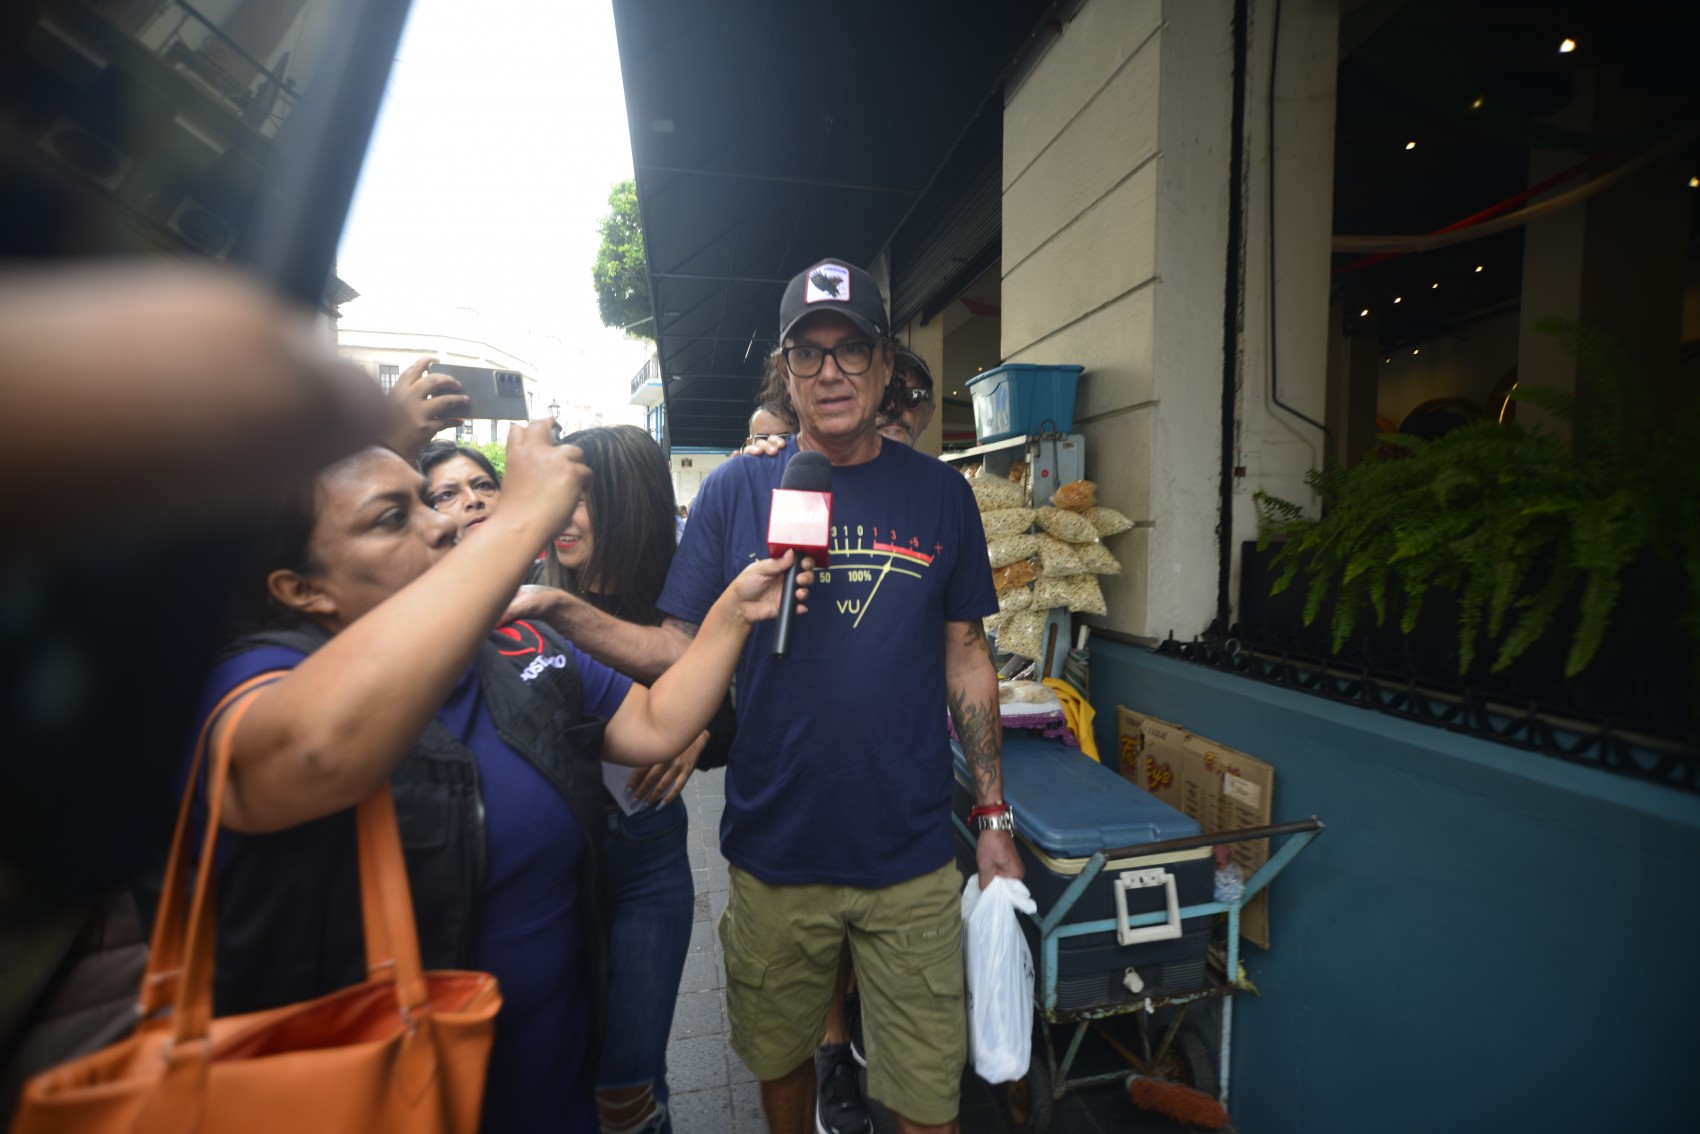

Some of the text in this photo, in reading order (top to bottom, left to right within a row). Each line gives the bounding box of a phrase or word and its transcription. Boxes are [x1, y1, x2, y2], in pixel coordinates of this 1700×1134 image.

[831, 525, 838, 538] 3
[843, 525, 849, 537] 1
[857, 525, 863, 536] 0
[820, 570, 871, 583] 50 100%
[836, 599, 860, 615] VU
